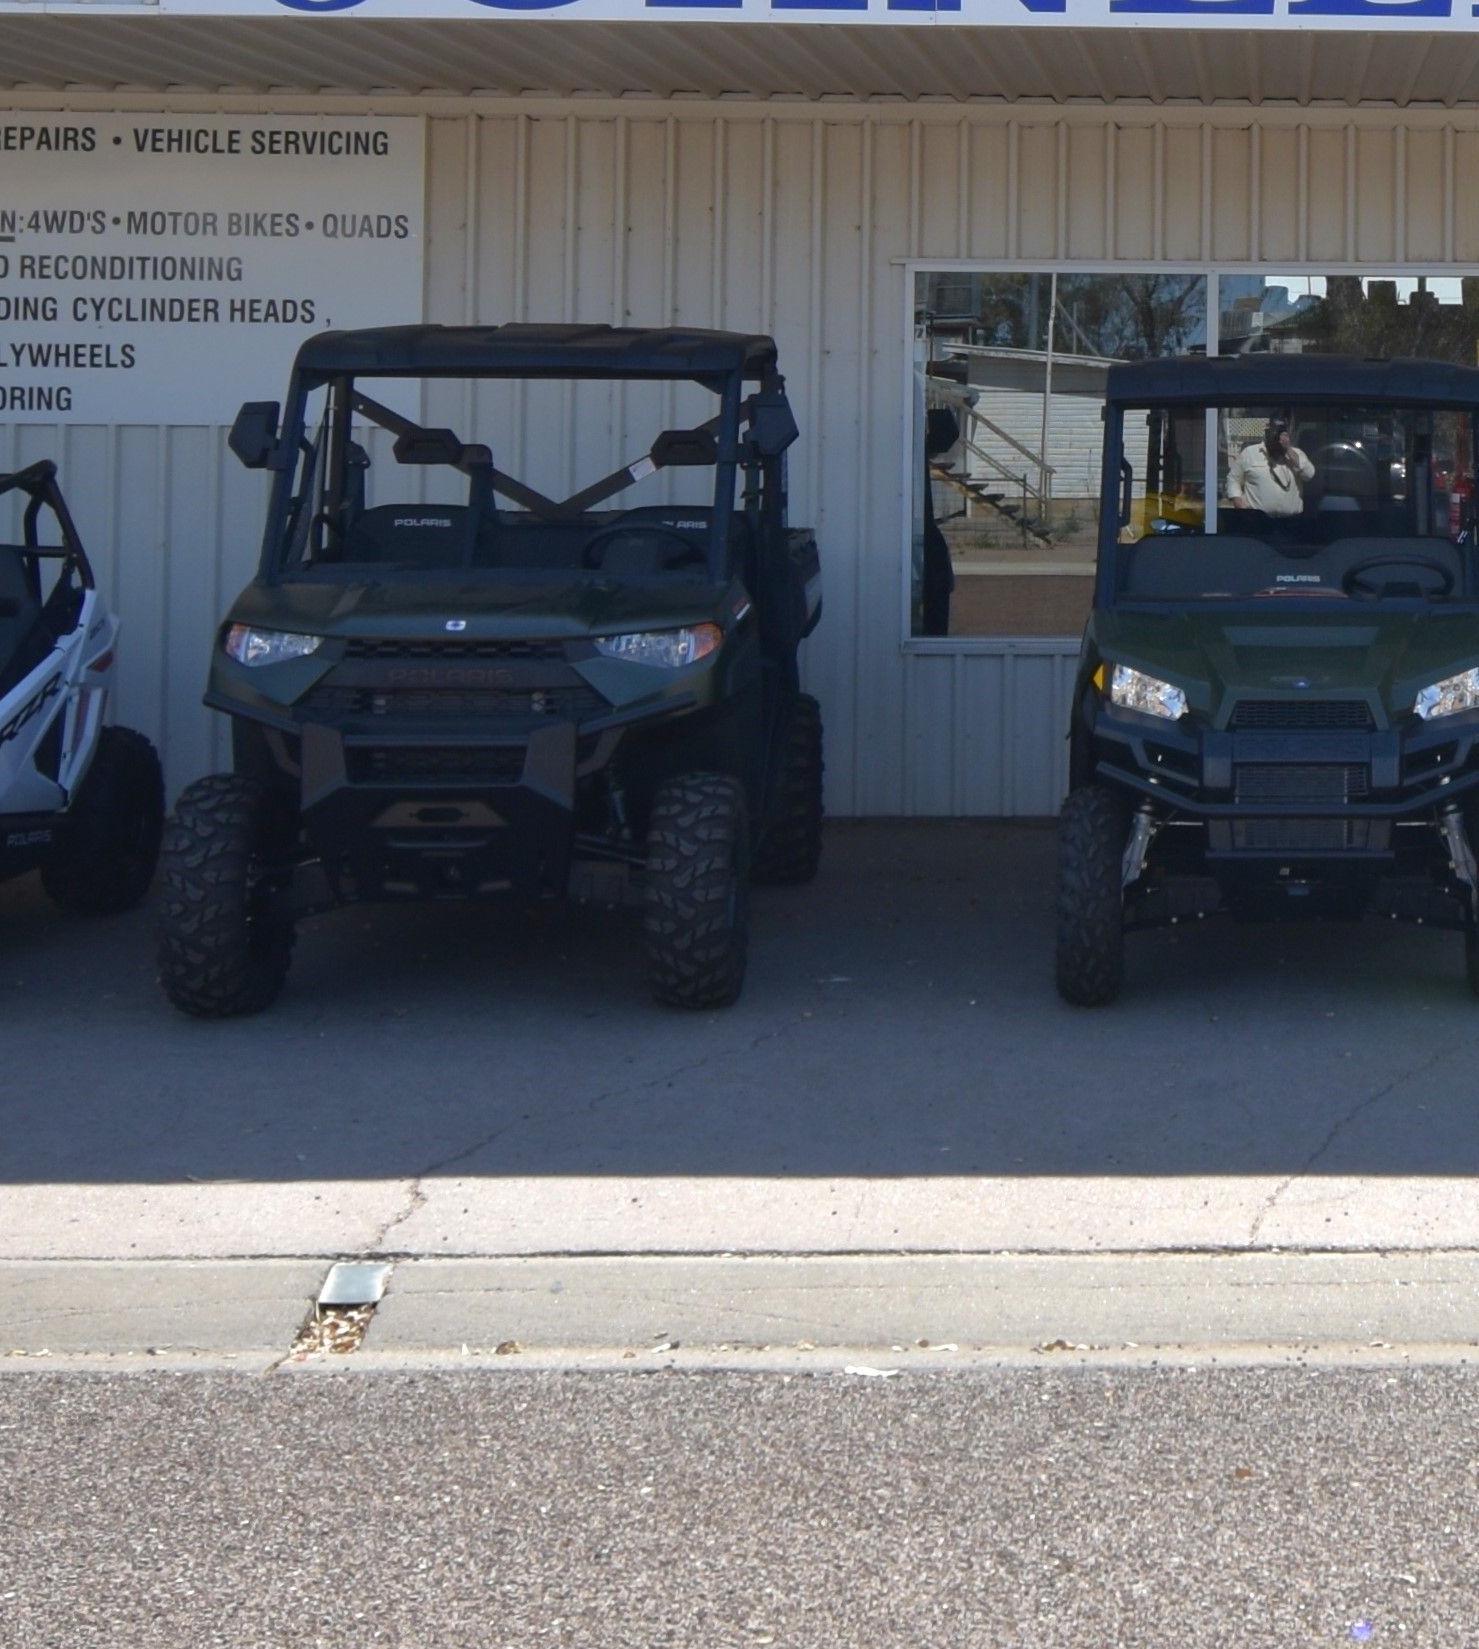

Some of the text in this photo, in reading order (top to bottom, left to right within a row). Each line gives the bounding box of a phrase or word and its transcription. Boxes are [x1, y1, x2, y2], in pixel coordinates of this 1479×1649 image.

[133, 128, 240, 153] VEHICLE
[251, 130, 388, 155] SERVICING
[127, 211, 217, 235] MOTOR
[228, 213, 299, 237] BIKES
[323, 214, 408, 239] QUADS
[20, 255, 241, 281] RECONDITIONING
[73, 297, 219, 322] CYCLINDER
[394, 518, 452, 528] POLARIS
